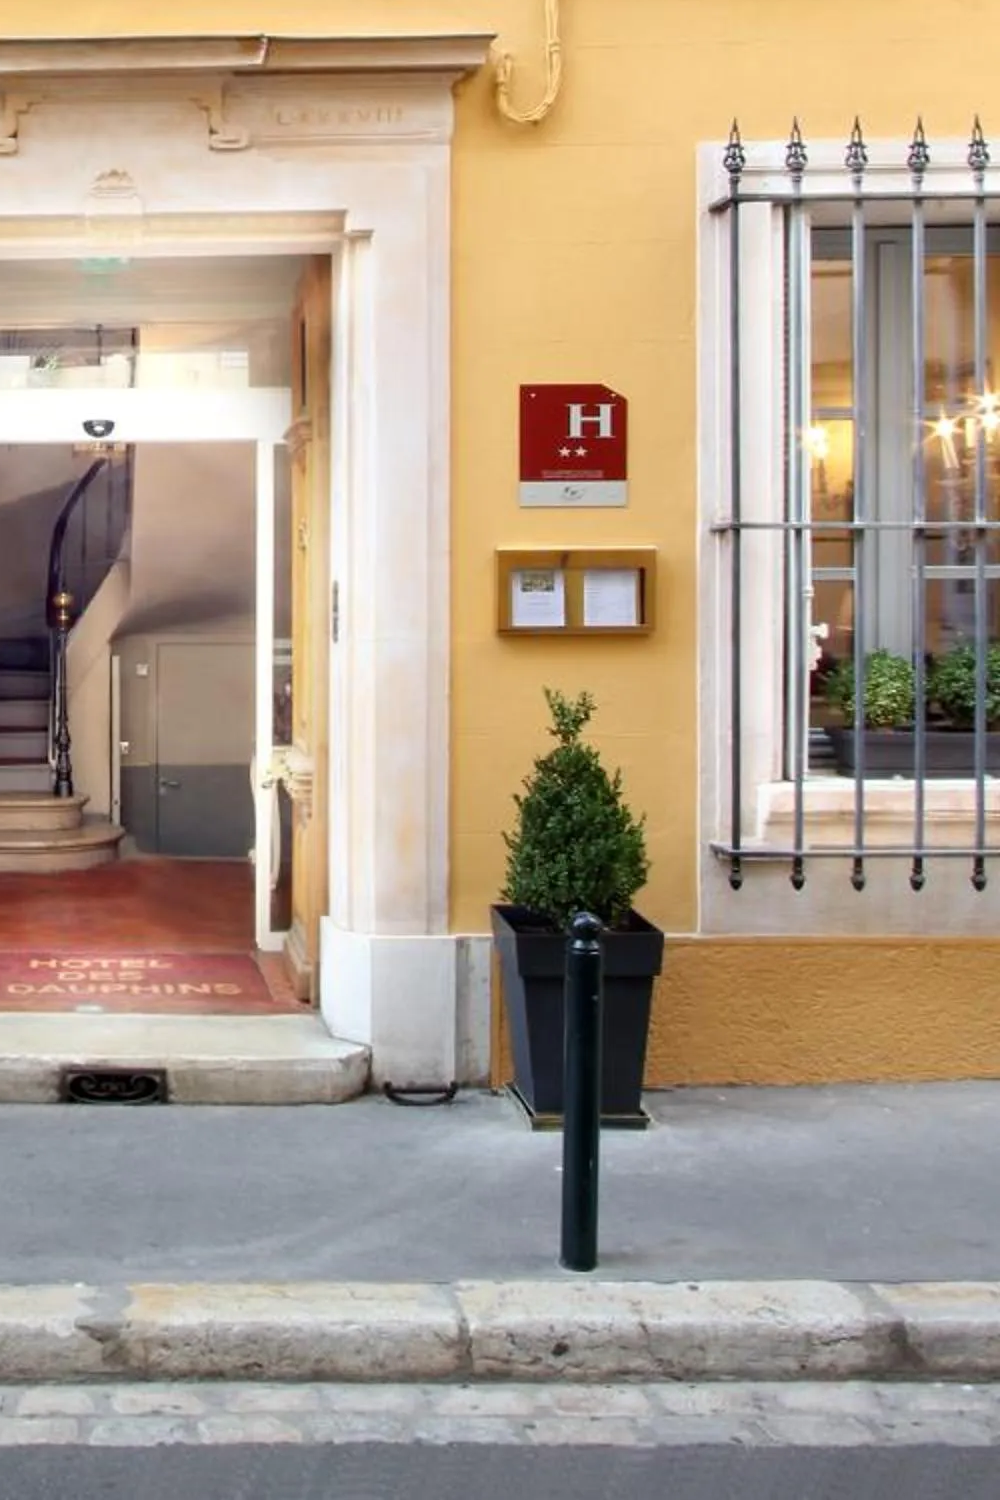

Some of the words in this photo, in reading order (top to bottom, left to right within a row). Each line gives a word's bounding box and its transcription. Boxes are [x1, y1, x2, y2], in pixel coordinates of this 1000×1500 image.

[564, 403, 616, 438] H
[28, 957, 174, 969] HOTEL
[56, 970, 144, 982] DES
[6, 982, 243, 996] DAUPHINS
